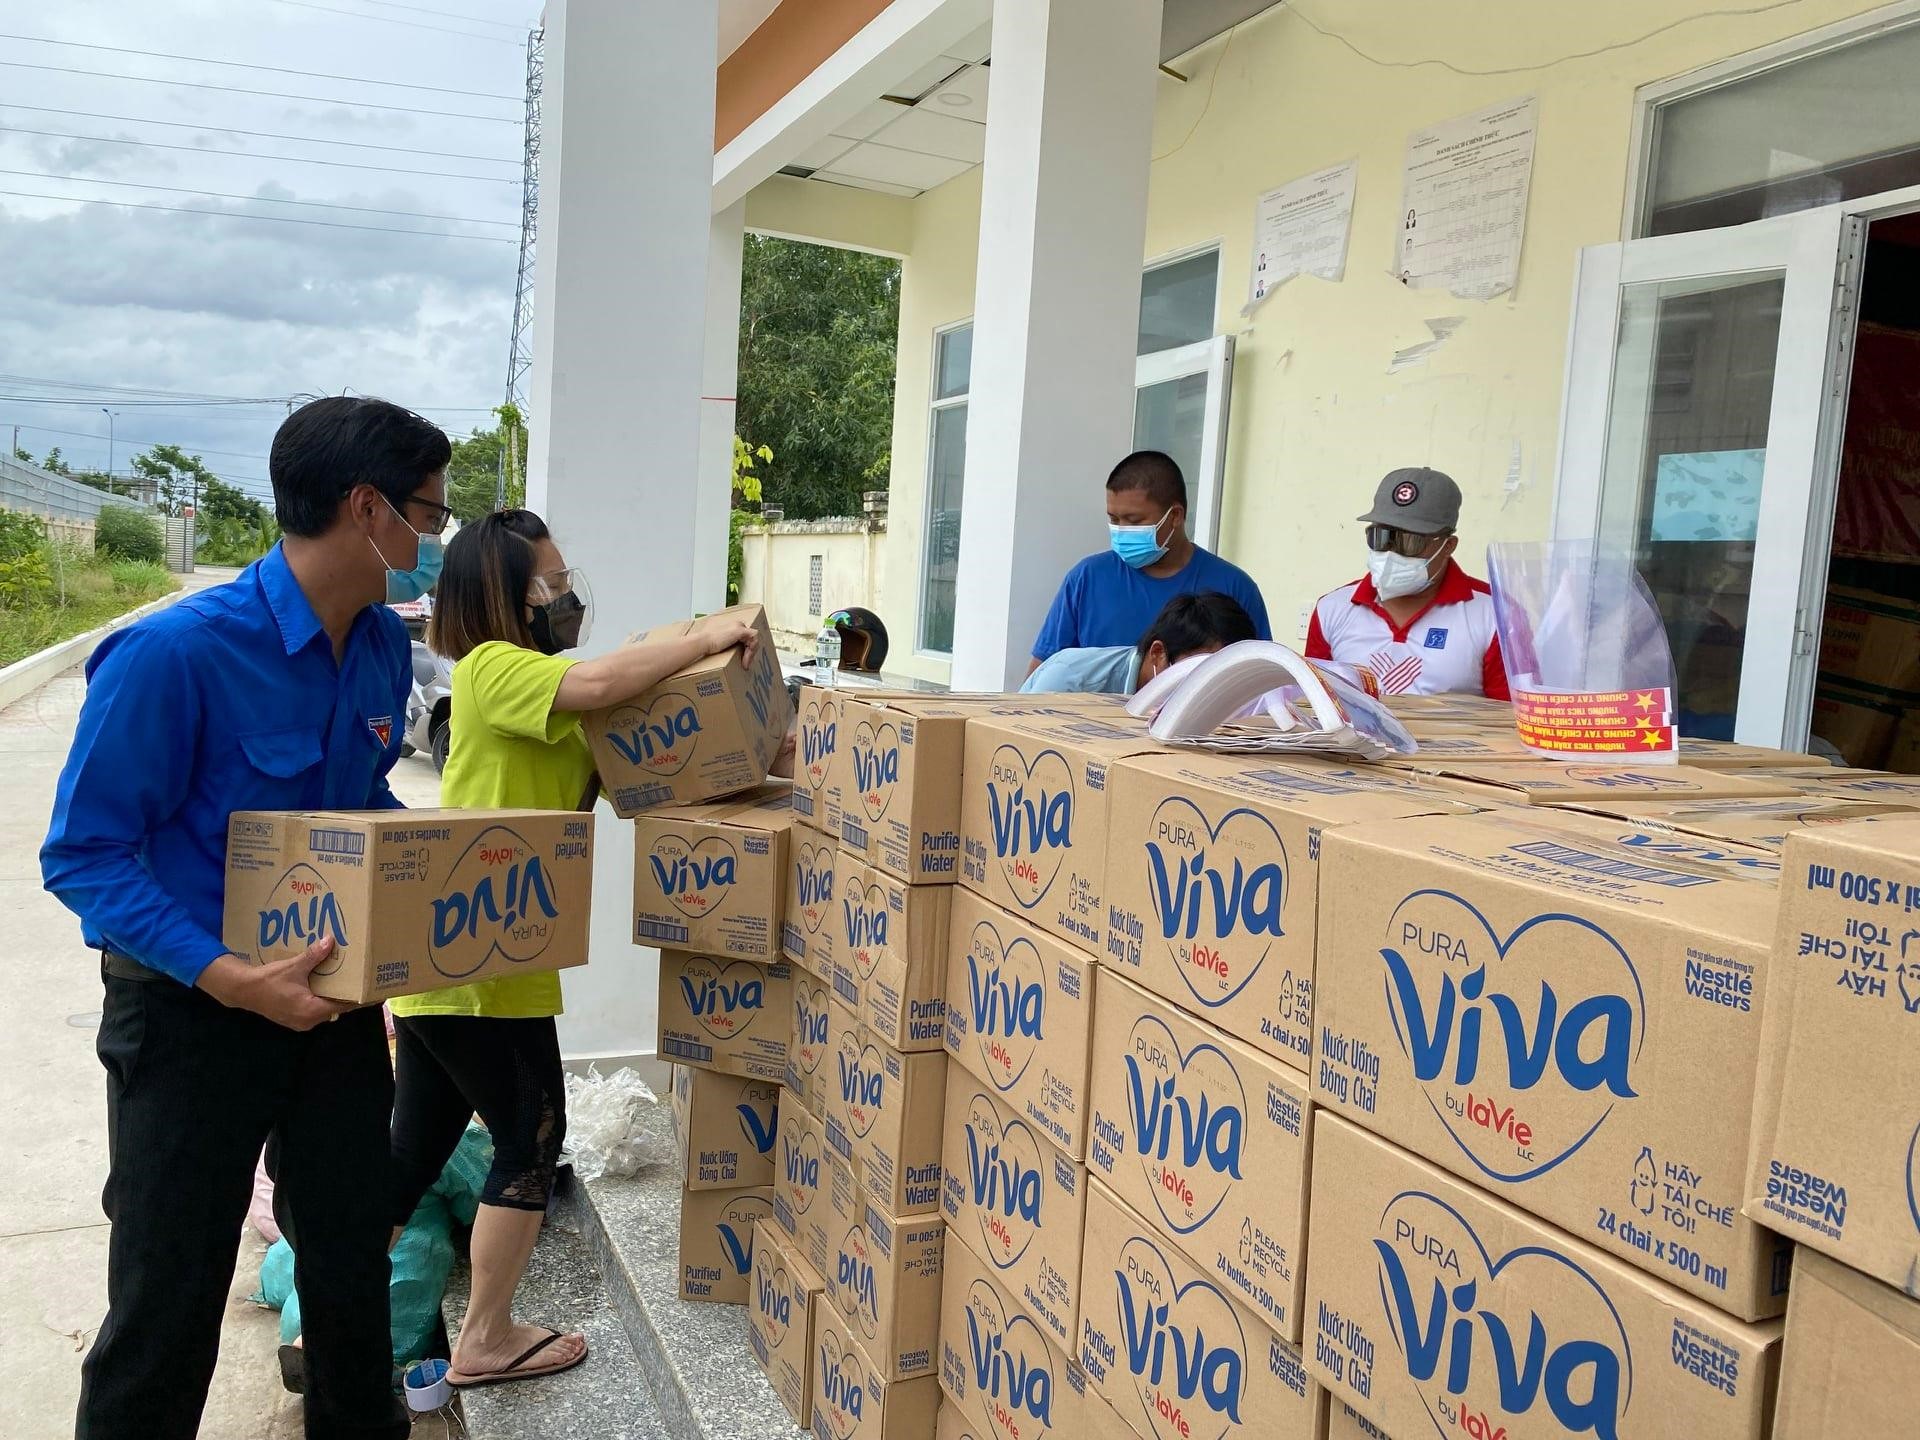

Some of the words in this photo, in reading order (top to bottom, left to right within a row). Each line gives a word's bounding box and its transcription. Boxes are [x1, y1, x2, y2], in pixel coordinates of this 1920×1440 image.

[1400, 488, 1412, 499] 3
[1596, 693, 1628, 702] CHUNG
[605, 706, 703, 765] Viva
[802, 723, 835, 765] Viva
[857, 735, 870, 747] PURA
[1584, 730, 1601, 738] TAY
[852, 746, 898, 793] Viva
[993, 768, 1019, 785] PURA
[1086, 767, 1105, 781] Nestlé
[1086, 777, 1105, 791] Waters
[564, 823, 587, 837] Water
[987, 782, 1072, 857] Viva
[1159, 822, 1197, 851] PURA
[556, 842, 587, 860] Purified
[657, 846, 682, 856] PURA
[922, 832, 960, 850] Purifie
[379, 861, 416, 871] RECYCLE
[384, 873, 415, 882] PLEASE
[649, 855, 736, 895] Viva
[922, 850, 955, 872] Water
[1007, 864, 1014, 876] by
[1015, 859, 1038, 884] laVie
[431, 856, 560, 948] Viva
[797, 863, 832, 906] Viva
[1145, 842, 1286, 939] Viva
[1808, 864, 1835, 890] ml
[1840, 871, 1881, 905] 500
[1886, 880, 1900, 903] x
[258, 892, 349, 947] Viva
[512, 924, 547, 941] PURA
[844, 898, 888, 947] Viva
[1109, 904, 1125, 934] Nước
[1126, 908, 1144, 944] Uống
[1845, 918, 1891, 945] TÔI!
[975, 939, 995, 964] PURA
[1108, 930, 1126, 962] Đóng
[1128, 941, 1141, 968] Chai
[1180, 944, 1190, 962] by
[1192, 942, 1229, 978] laVie
[1402, 923, 1470, 967] PURA
[1799, 933, 1846, 957] CHẾ
[1853, 945, 1889, 973] TÁI
[377, 959, 409, 974] Waters
[688, 967, 712, 978] PURA
[1059, 967, 1080, 989] Nestlé
[1686, 960, 1752, 995] Nestlé
[1836, 969, 1886, 998] HÃY
[679, 976, 764, 1016] Viva
[967, 955, 1043, 1041] Viva
[1059, 980, 1080, 1000] Waters
[1219, 980, 1229, 991] LLC
[1685, 978, 1750, 1012] Waters
[711, 1016, 734, 1027] laVie
[911, 999, 945, 1019] Purifie
[948, 1003, 967, 1035] Purified
[1379, 948, 1639, 1098] Viva
[910, 1022, 943, 1040] Water
[947, 1025, 961, 1053] Water
[1261, 1018, 1271, 1034] 24
[1272, 1022, 1289, 1045] chai
[1290, 1034, 1295, 1047] x
[991, 1040, 1012, 1069] laVie
[1137, 1036, 1168, 1074] PURA
[1322, 1027, 1348, 1067] Nước
[1351, 1039, 1379, 1084] Uống
[838, 1051, 883, 1110] Viva
[1052, 1076, 1073, 1099] PLEASE
[1320, 1060, 1347, 1105] Đóng
[1354, 1075, 1376, 1115] Chai
[1051, 1087, 1076, 1113] RECYCLE
[1124, 1054, 1243, 1180] Viva
[1268, 1090, 1300, 1124] Nestlé
[974, 1111, 994, 1140] PURA
[1094, 1110, 1124, 1154] Purified
[1267, 1107, 1300, 1138] Waters
[1445, 1092, 1464, 1118] by
[1467, 1092, 1533, 1147] laVie
[784, 1135, 819, 1189] Viva
[1092, 1138, 1114, 1174] Water
[1517, 1146, 1535, 1163] LLC
[906, 1163, 942, 1185] Purifie
[944, 1168, 966, 1204] Purified
[966, 1124, 1041, 1228] Viva
[1152, 1164, 1161, 1184] by
[1162, 1166, 1194, 1208] laVie
[1665, 1161, 1701, 1188] HÃY
[1772, 1159, 1847, 1207] Waters
[905, 1186, 939, 1205] Water
[944, 1191, 959, 1220] Water
[1664, 1182, 1690, 1210] TÁI
[1694, 1196, 1735, 1228] CHẾ
[1766, 1177, 1846, 1228] Nestlé
[990, 1215, 1011, 1248] laVie
[1661, 1205, 1696, 1234] TÔI!
[1255, 1228, 1286, 1261] PLEASE
[1396, 1218, 1461, 1278] PURA
[1597, 1207, 1616, 1235] 24
[1620, 1216, 1652, 1256] chai
[1655, 1234, 1664, 1258] x
[1668, 1235, 1700, 1276] 500
[1705, 1252, 1727, 1290] ml
[685, 1265, 721, 1283] Purified
[1127, 1255, 1162, 1301] PURA
[1253, 1259, 1267, 1278] ME!
[1254, 1246, 1291, 1282] RECYCLE
[685, 1280, 712, 1297] Water
[757, 1265, 790, 1328] Viva
[839, 1250, 878, 1323] Viva
[1217, 1252, 1226, 1269] 24
[1227, 1259, 1252, 1292] bottles
[1253, 1285, 1258, 1299] x
[1259, 1287, 1273, 1314] 500
[1274, 1303, 1285, 1323] ml
[973, 1294, 997, 1331] PURA
[1085, 1317, 1115, 1368] Purified
[1115, 1270, 1243, 1425] Viva
[1319, 1300, 1344, 1343] Nước
[1347, 1313, 1374, 1363] Uống
[1373, 1239, 1621, 1440] Viva
[965, 1305, 1052, 1429] Viva
[1083, 1343, 1107, 1385] Water
[1269, 1345, 1307, 1385] Nestlé
[1316, 1332, 1343, 1383] Đóng
[1348, 1357, 1371, 1400] Chai
[1672, 1347, 1736, 1396] Waters
[1673, 1329, 1738, 1380] Nestlé
[821, 1344, 862, 1422] Viva
[1269, 1356, 1305, 1398] Waters
[995, 1402, 1019, 1440] laVie
[1145, 1386, 1155, 1407] by
[1156, 1391, 1190, 1439] laVie
